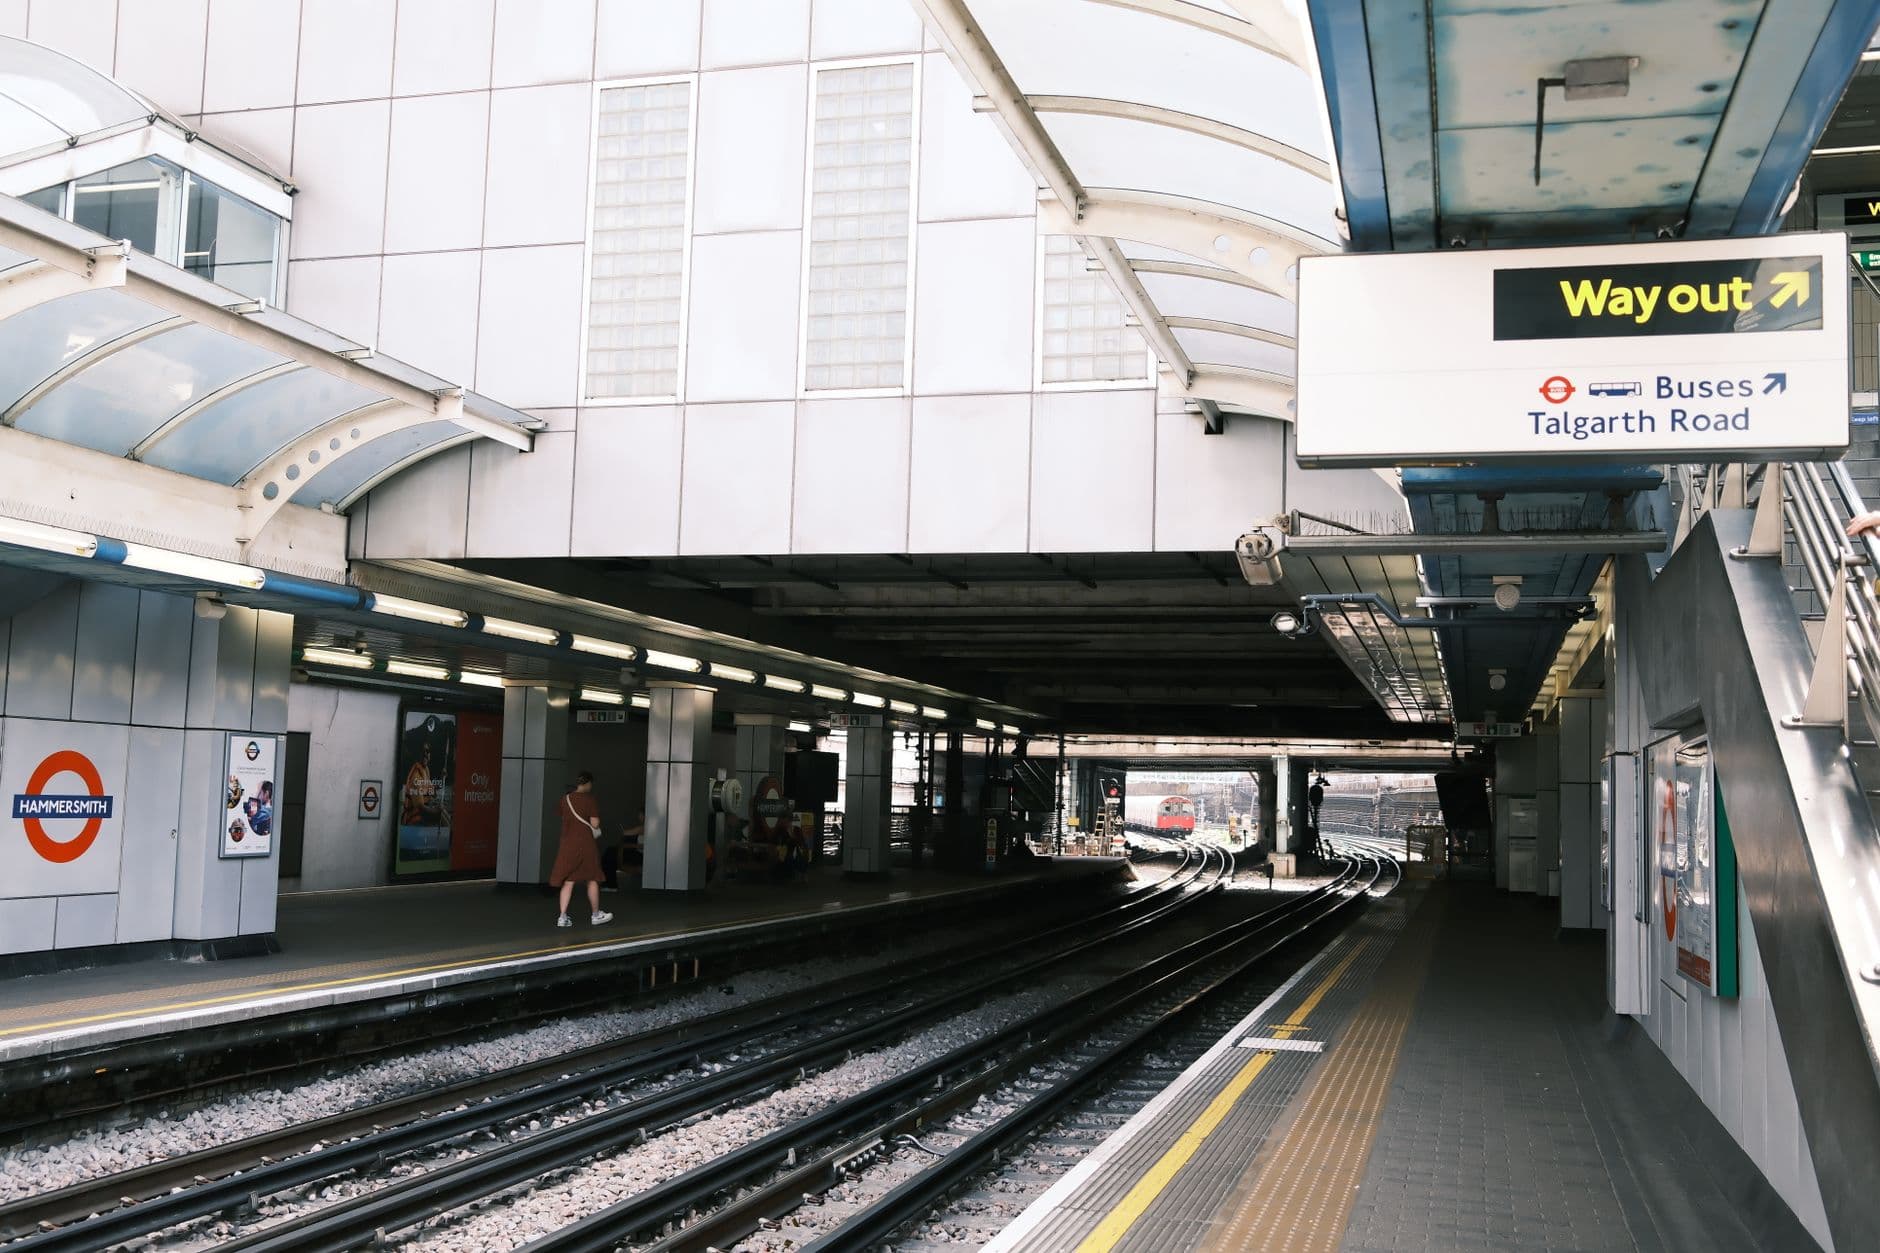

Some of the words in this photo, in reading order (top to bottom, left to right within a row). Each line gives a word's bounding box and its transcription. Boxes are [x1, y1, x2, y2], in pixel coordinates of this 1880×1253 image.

[1559, 278, 1662, 324] Way
[1667, 276, 1753, 314] out
[1656, 376, 1754, 399] Buses
[1528, 410, 1656, 440] Talgarth
[1670, 407, 1750, 432] Road
[471, 772, 489, 789] Only
[19, 799, 107, 814] HAMMERSMITH
[464, 790, 495, 803] Intrepid
